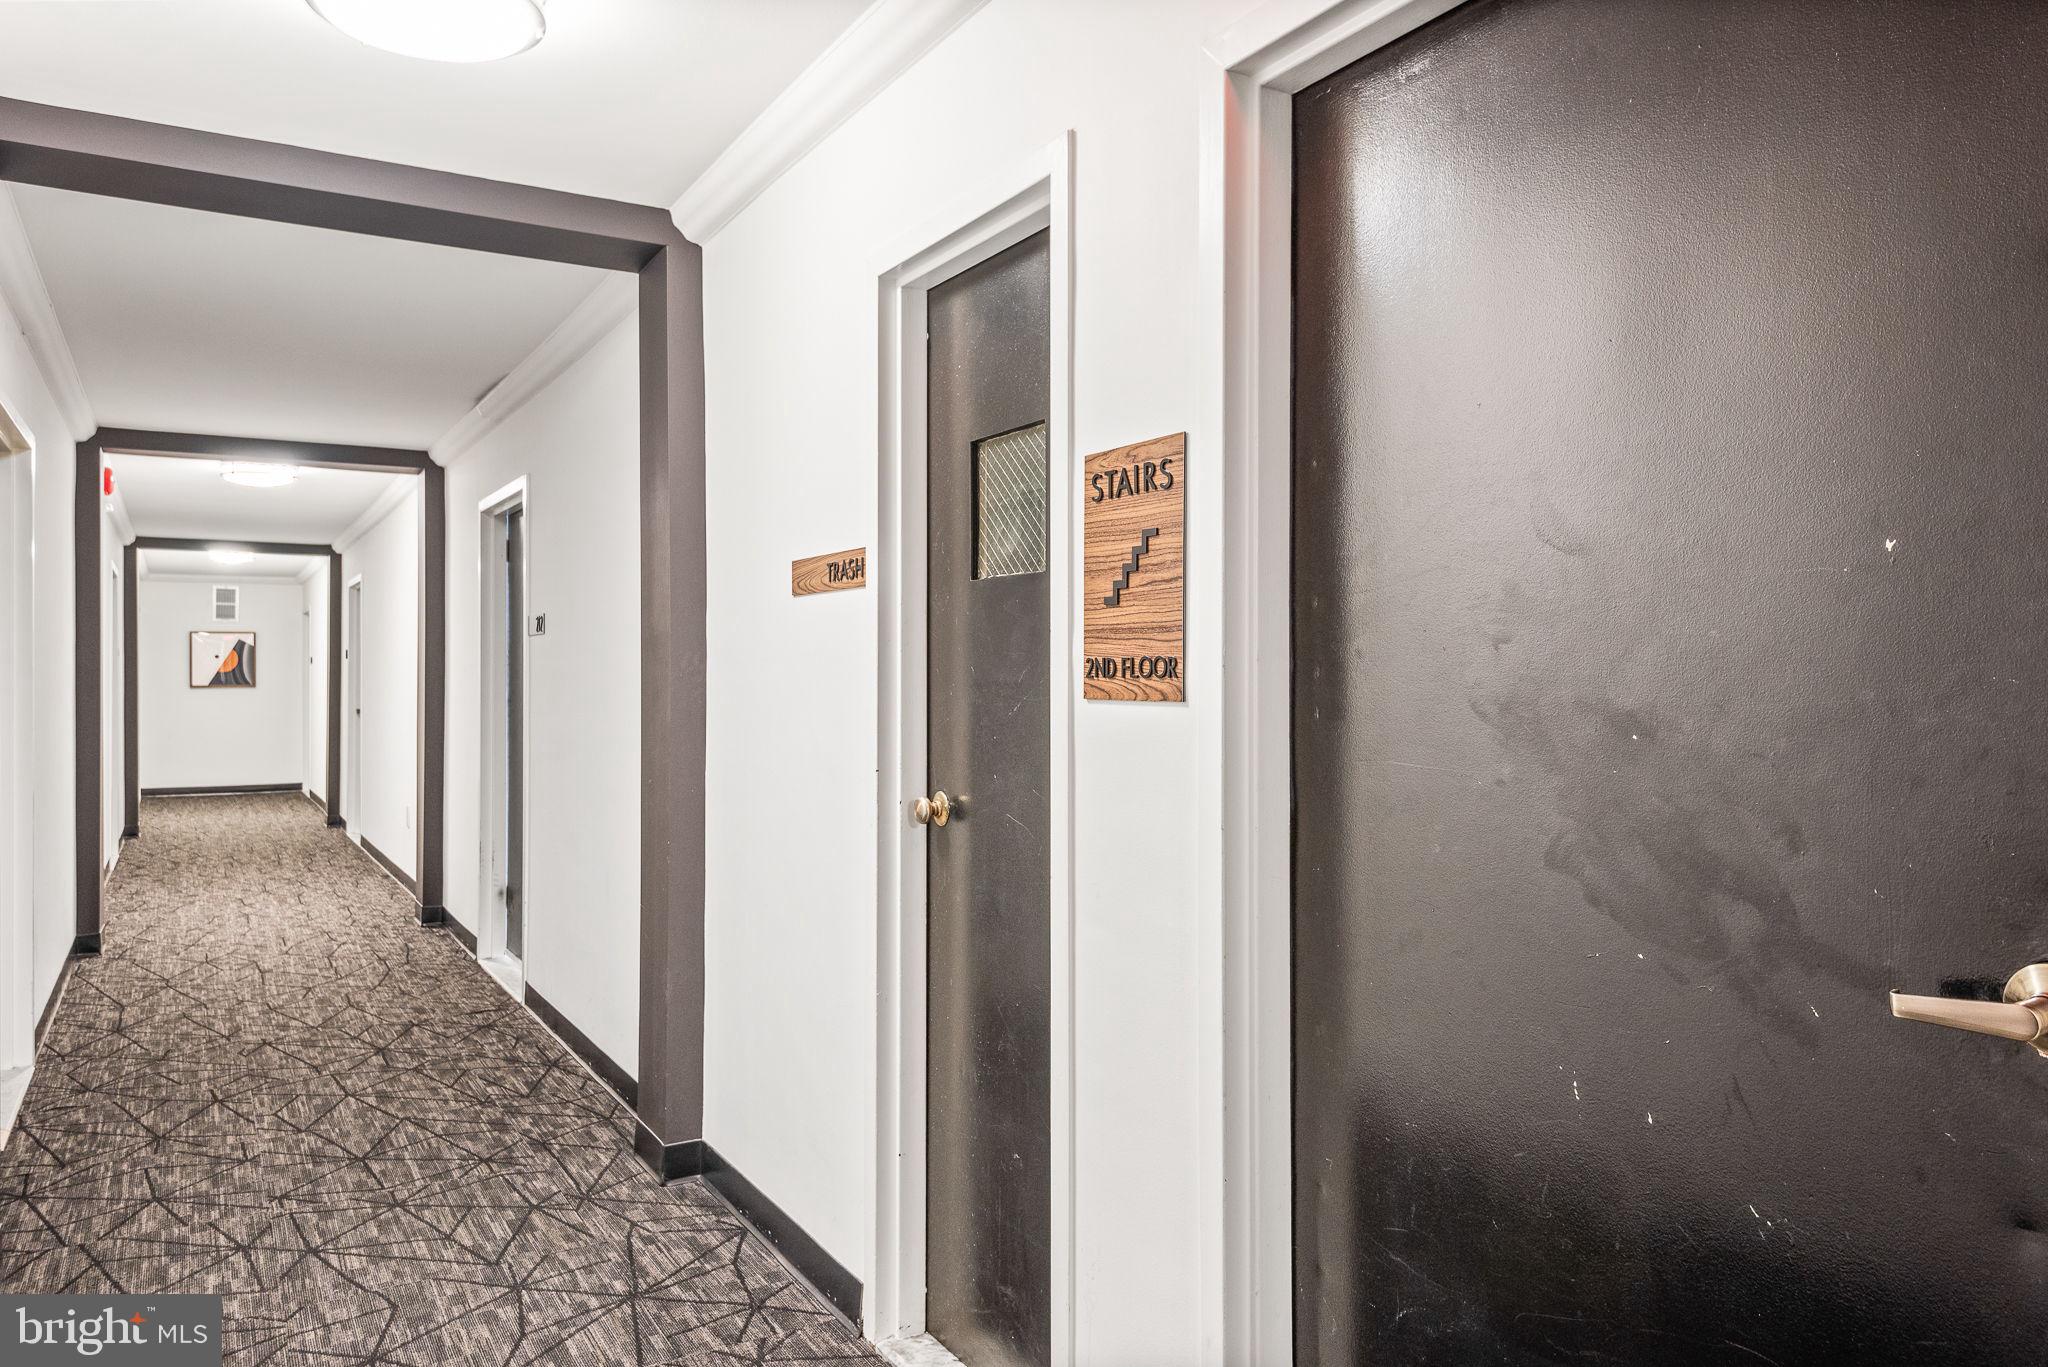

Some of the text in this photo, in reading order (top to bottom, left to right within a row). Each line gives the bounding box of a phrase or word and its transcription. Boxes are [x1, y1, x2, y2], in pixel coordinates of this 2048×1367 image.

[1092, 458, 1174, 502] STAIRS
[827, 557, 864, 583] TRASH
[1086, 656, 1178, 680] 2ND FLOOR
